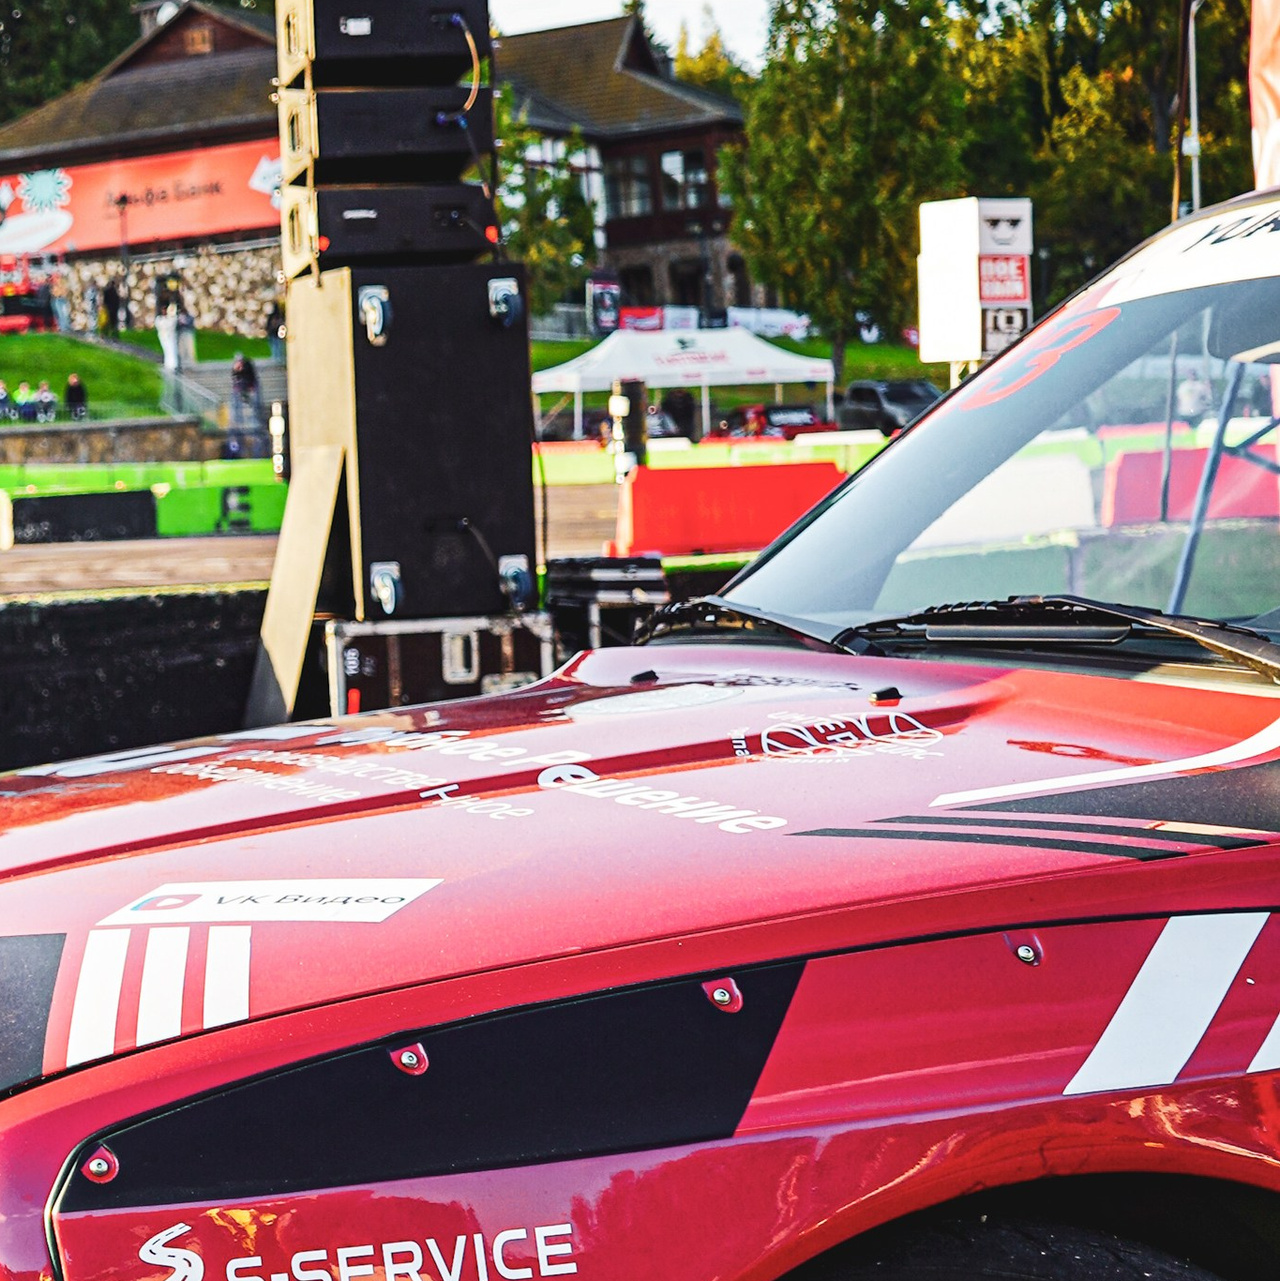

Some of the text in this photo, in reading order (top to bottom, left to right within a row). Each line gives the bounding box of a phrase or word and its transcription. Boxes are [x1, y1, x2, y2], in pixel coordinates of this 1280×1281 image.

[105, 185, 169, 208] Аьфа
[501, 750, 787, 833] Решение
[216, 894, 406, 906] VK Видео
